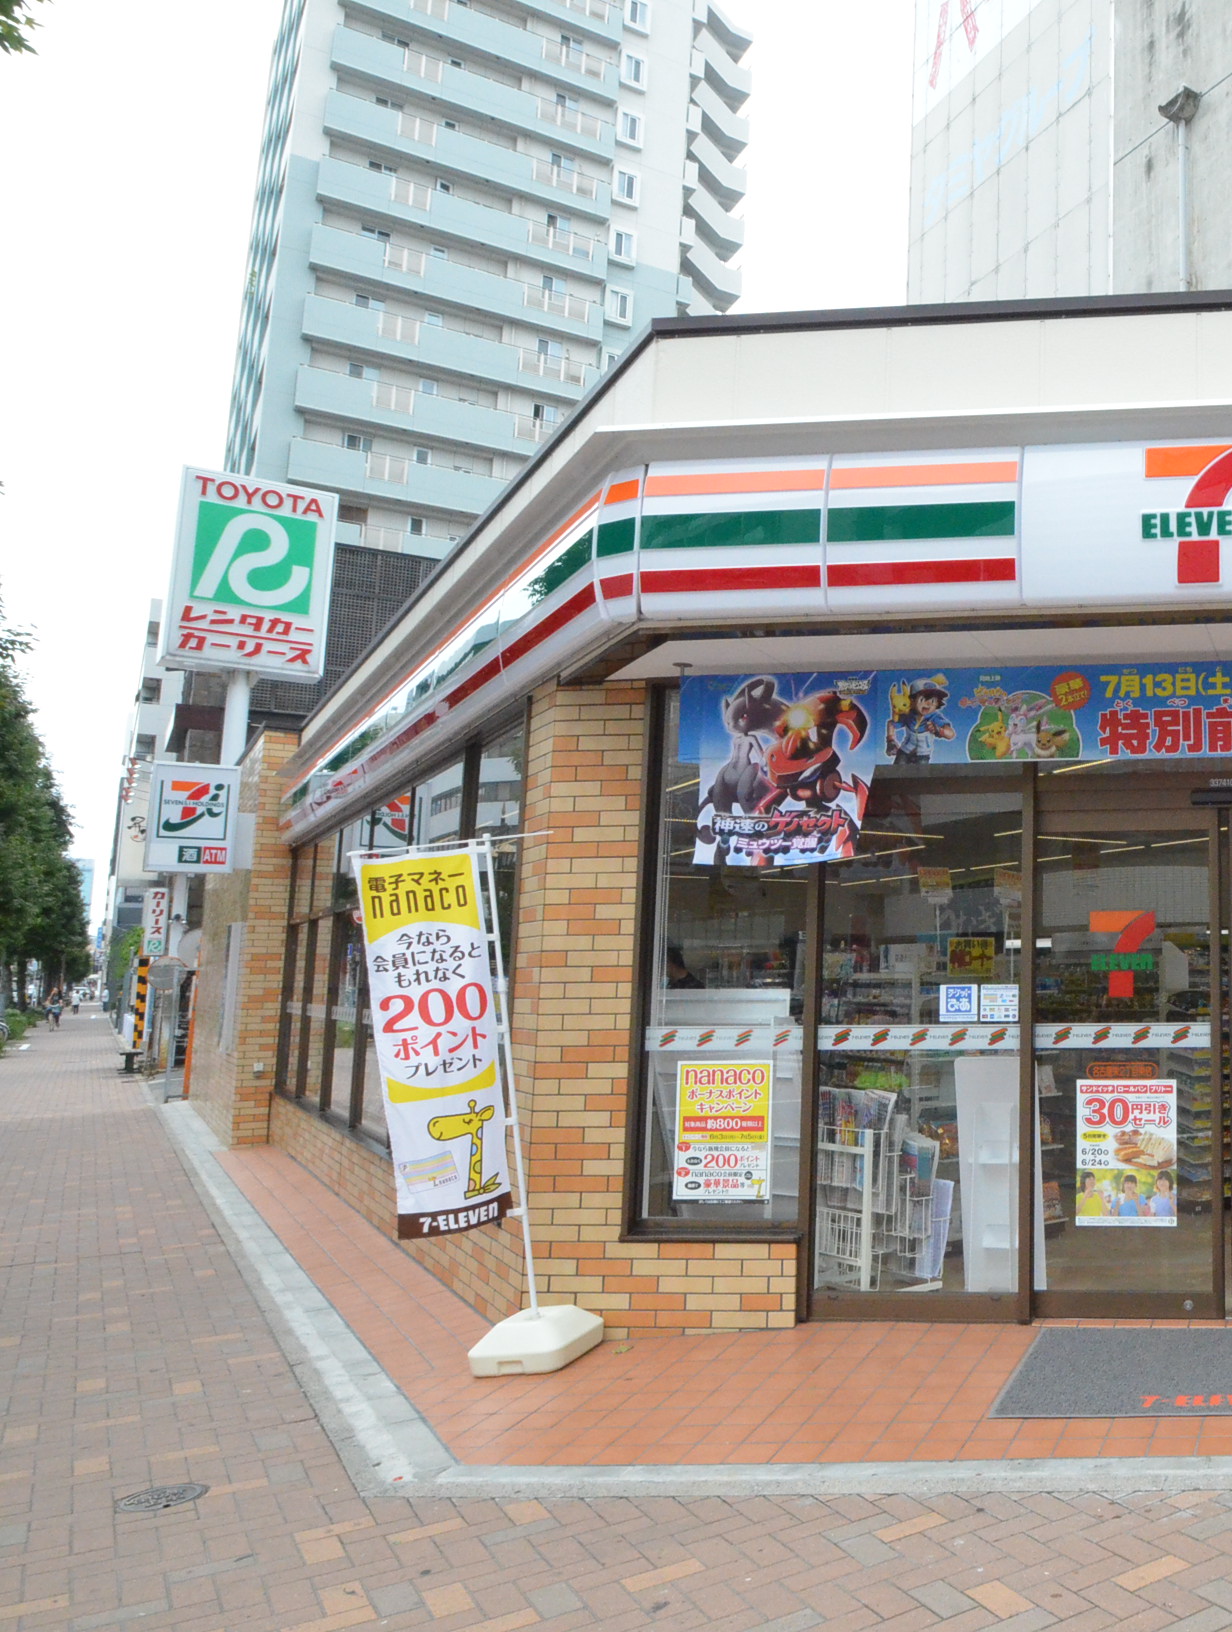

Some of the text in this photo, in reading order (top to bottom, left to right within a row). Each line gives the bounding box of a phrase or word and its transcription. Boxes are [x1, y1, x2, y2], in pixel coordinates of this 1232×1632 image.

[194, 475, 325, 519] TOYOTA
[181, 605, 315, 636] レンタカー
[178, 631, 313, 665] カーリース
[713, 810, 848, 833] 神速のゲノセクト
[181, 848, 198, 862] 酒
[203, 849, 226, 862] ATM
[368, 869, 465, 893] 電子マネー
[151, 891, 166, 935] カーリース
[371, 884, 468, 919] nanaco
[396, 929, 452, 951] 今なら
[372, 942, 482, 973] 会員になると
[394, 963, 466, 989] もれなく
[379, 982, 488, 1034] 200
[393, 1026, 487, 1060] ポイント
[405, 1054, 483, 1079] プレゼント
[685, 1068, 766, 1086] nanaco
[688, 1088, 763, 1100] ボーナスポイント
[696, 1102, 753, 1114] キャンペーン
[1084, 1097, 1130, 1126] 30
[1131, 1103, 1169, 1115] 円引き
[1131, 1115, 1171, 1126] セール
[703, 1153, 739, 1169] 200
